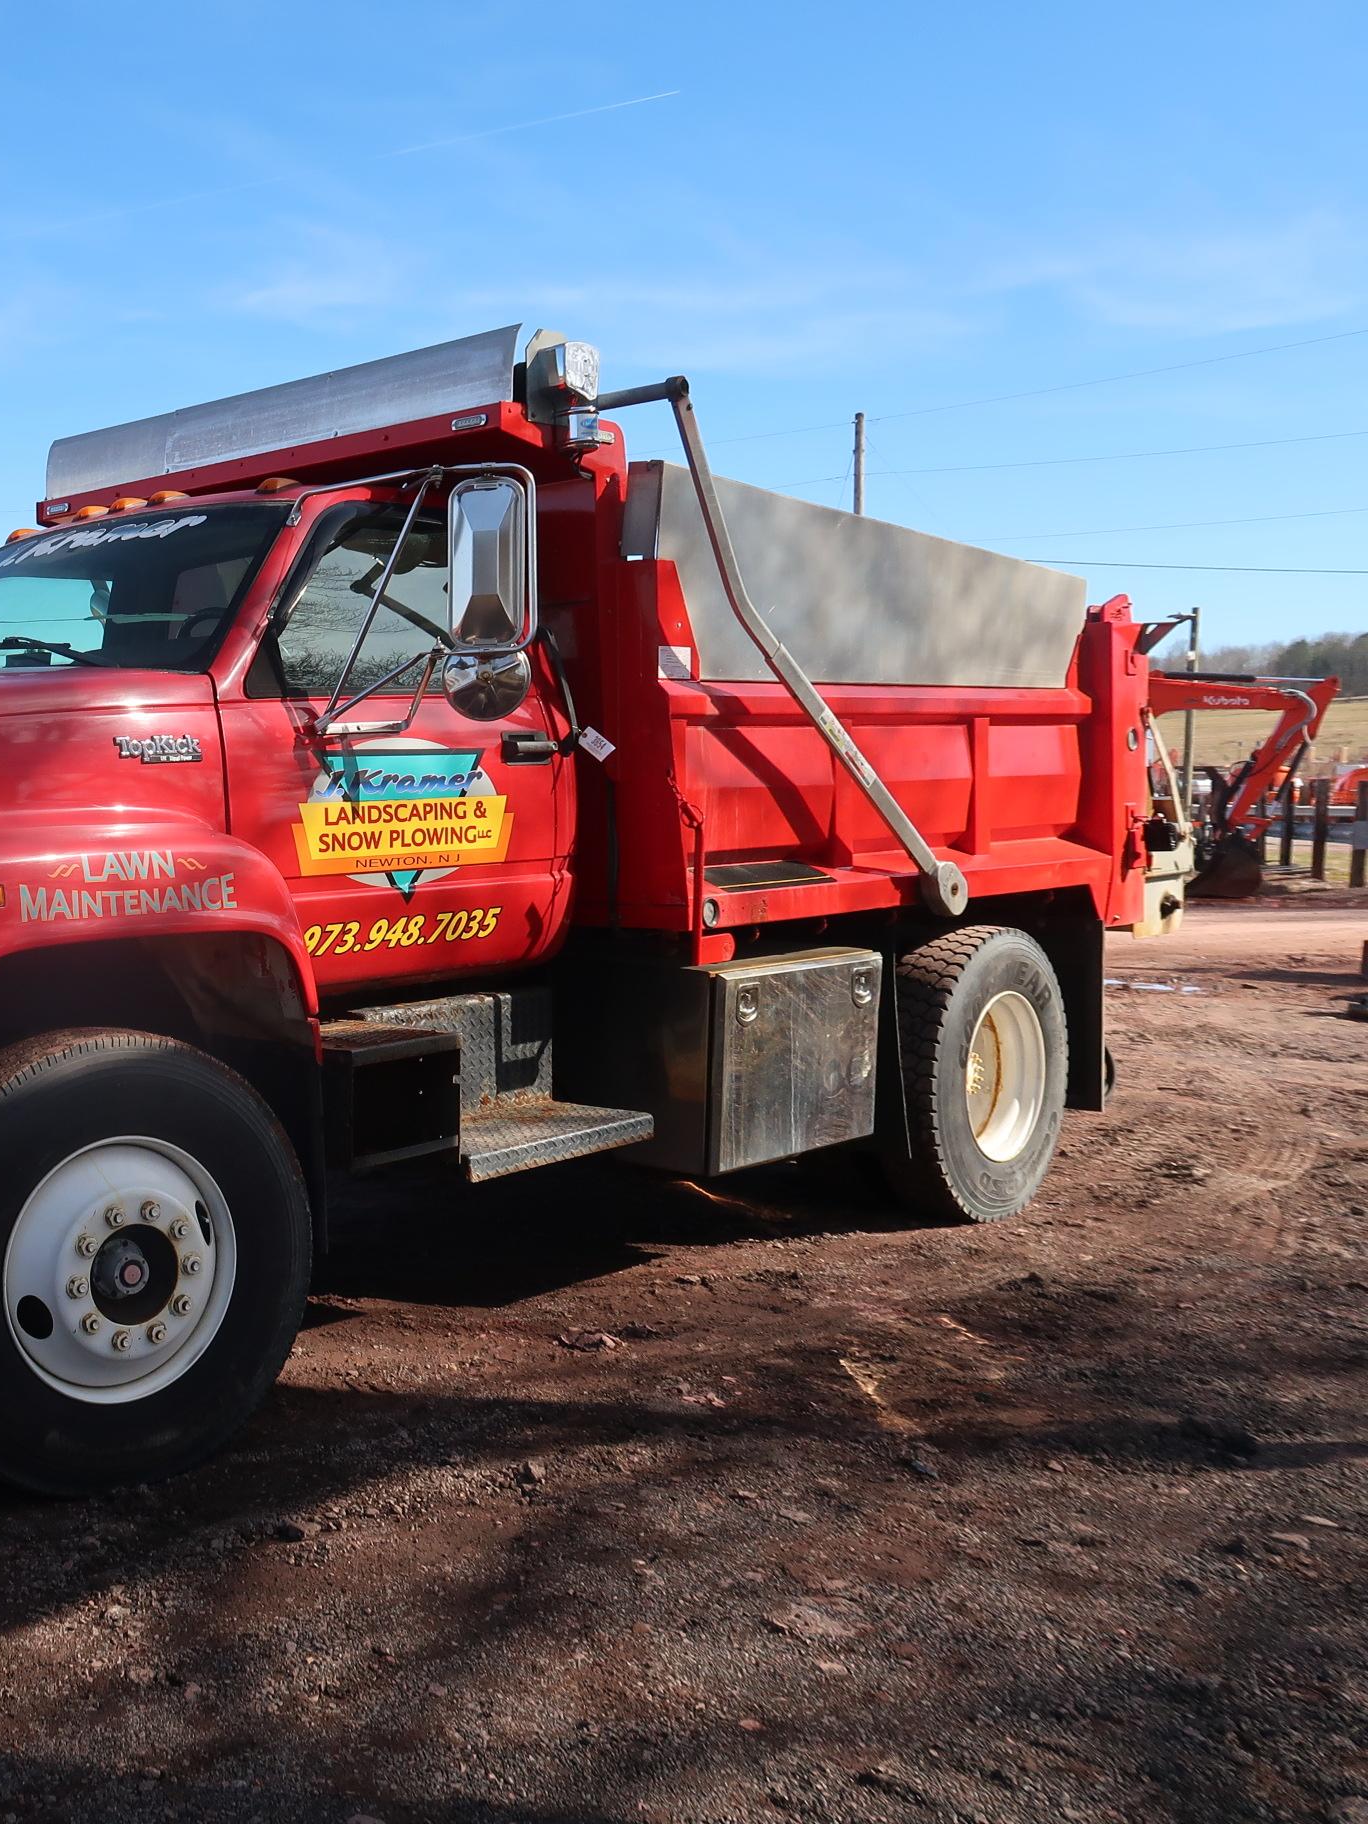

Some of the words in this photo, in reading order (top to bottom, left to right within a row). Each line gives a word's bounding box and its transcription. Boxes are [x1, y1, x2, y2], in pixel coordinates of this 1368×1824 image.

[114, 734, 202, 761] TopKick
[315, 768, 345, 798] J.
[347, 768, 483, 797] Kramer
[324, 801, 467, 826] LANDSCAPING
[473, 800, 488, 819] &
[318, 830, 383, 852] SNOW
[389, 825, 477, 849] PLOWING
[80, 849, 176, 883] LAWN
[18, 873, 238, 923] MAINTENANCE
[303, 907, 503, 957] 973.948.7035
